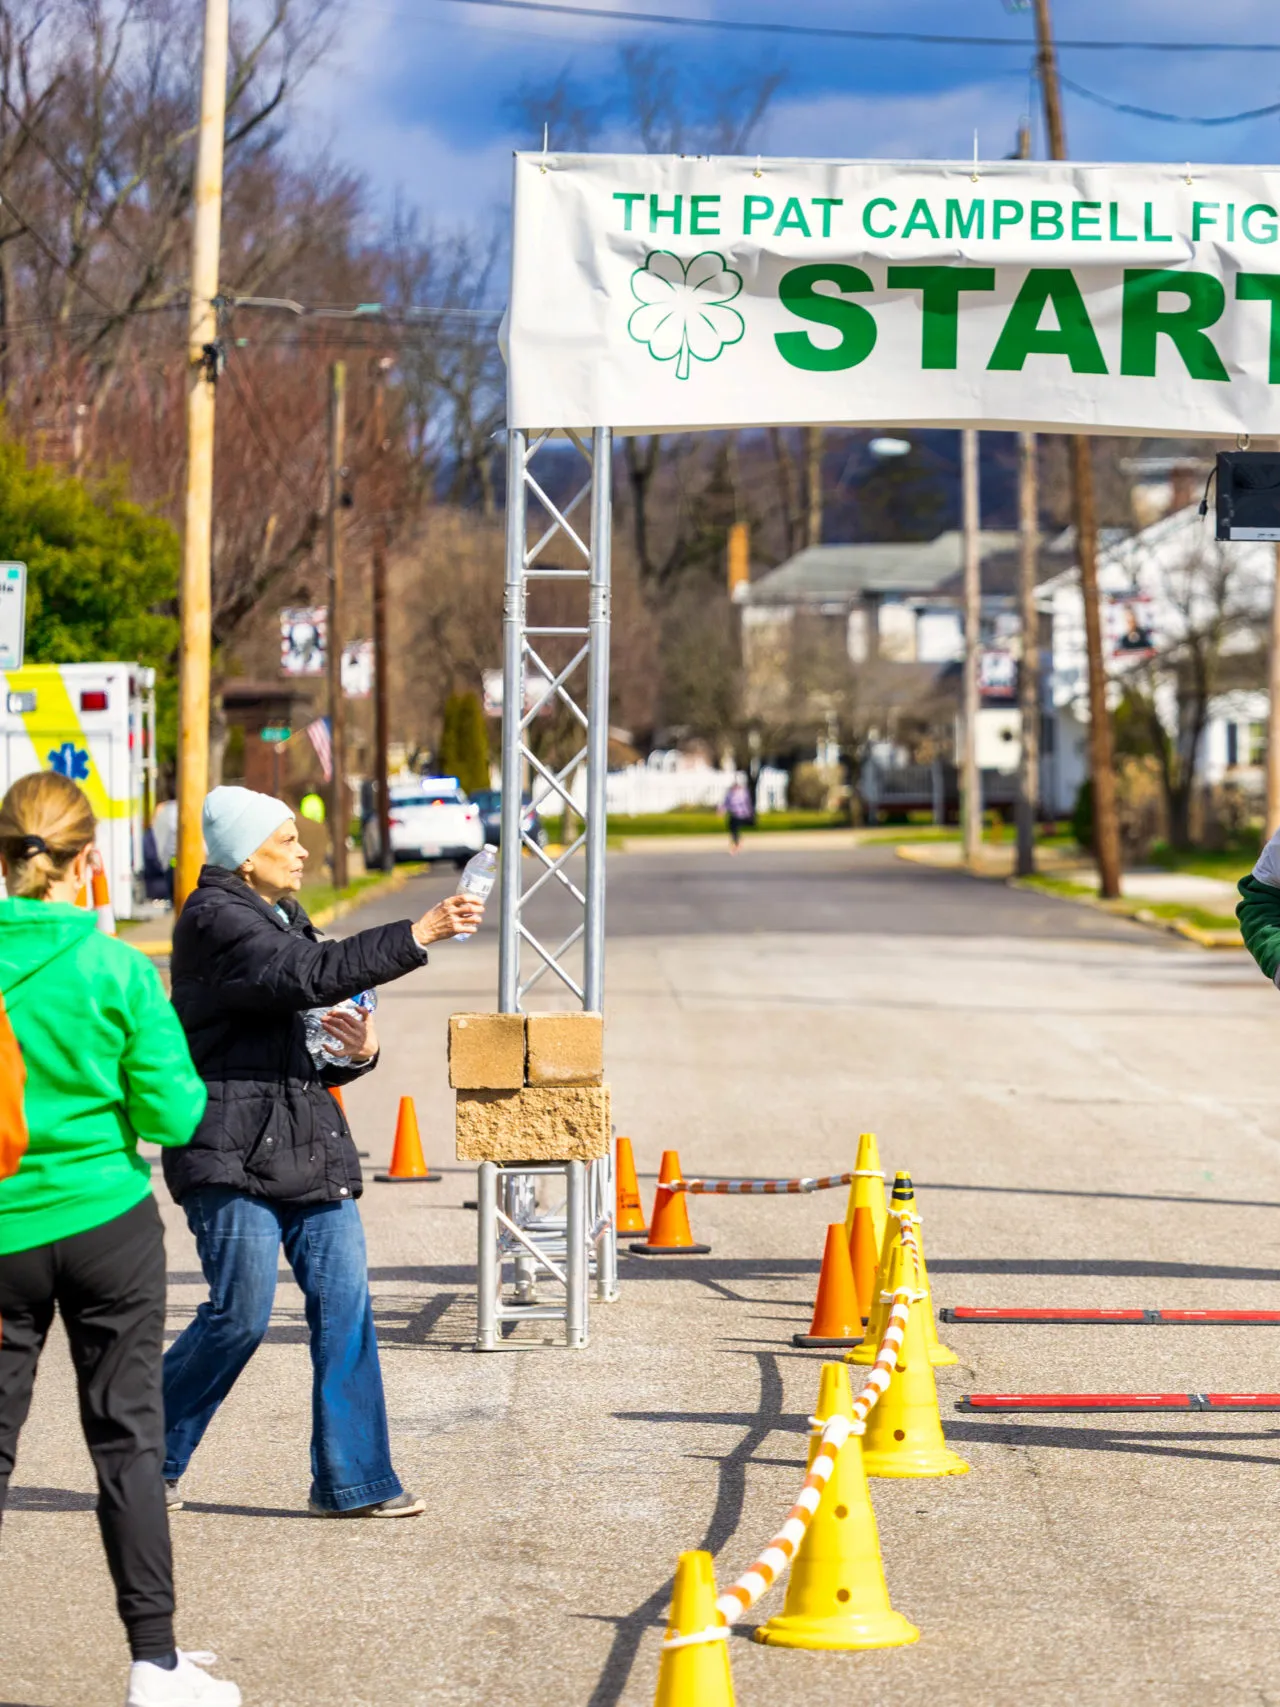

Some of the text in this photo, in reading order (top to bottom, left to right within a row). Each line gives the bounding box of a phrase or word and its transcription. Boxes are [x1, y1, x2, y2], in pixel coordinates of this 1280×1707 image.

[612, 192, 721, 236] THE
[742, 193, 844, 238] PAT
[861, 196, 1173, 243] CAMPBELL
